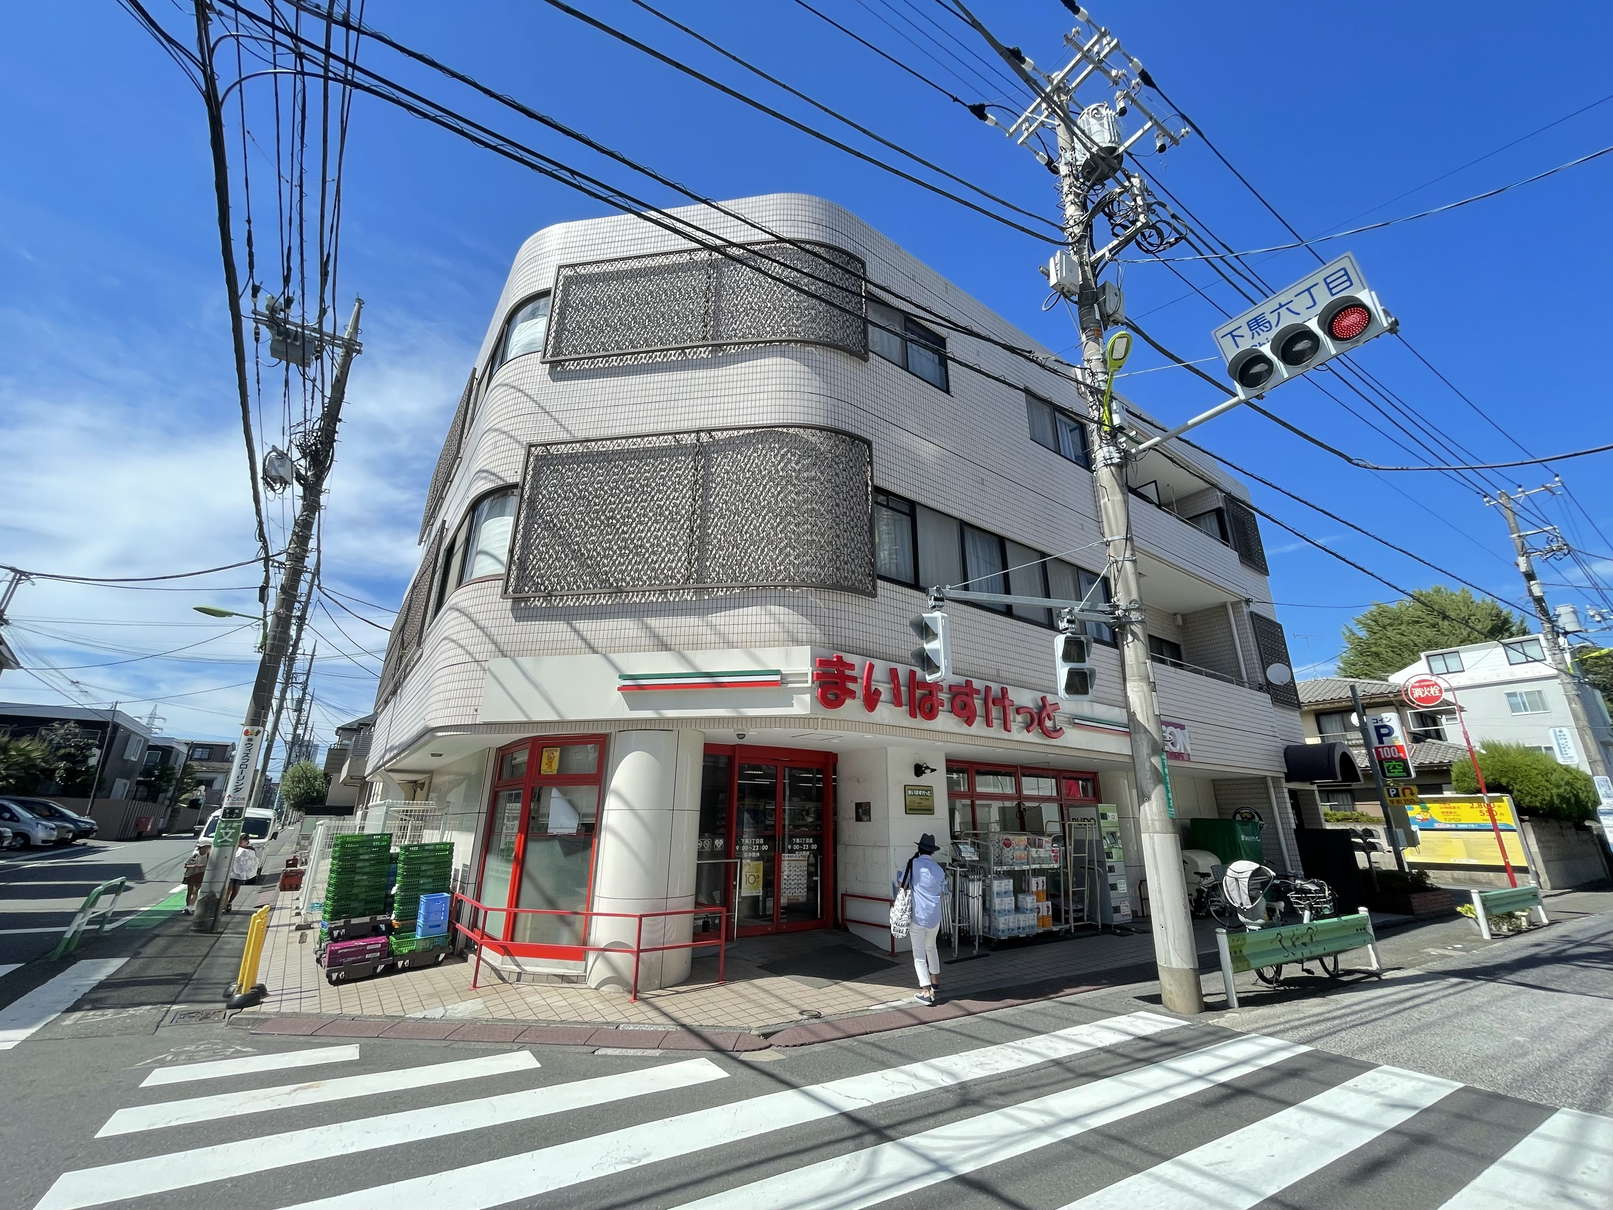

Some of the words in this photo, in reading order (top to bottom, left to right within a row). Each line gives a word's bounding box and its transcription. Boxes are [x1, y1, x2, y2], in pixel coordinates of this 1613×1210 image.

[1221, 267, 1354, 349] 下馬六丁目
[813, 653, 1064, 739] まいばすけっと
[1411, 685, 1440, 699] 消火栓
[1372, 716, 1392, 725] コイン
[1374, 725, 1394, 745] P
[1378, 746, 1398, 758] 100
[1383, 760, 1407, 777] 空
[1389, 788, 1396, 798] P
[217, 829, 236, 843] 文
